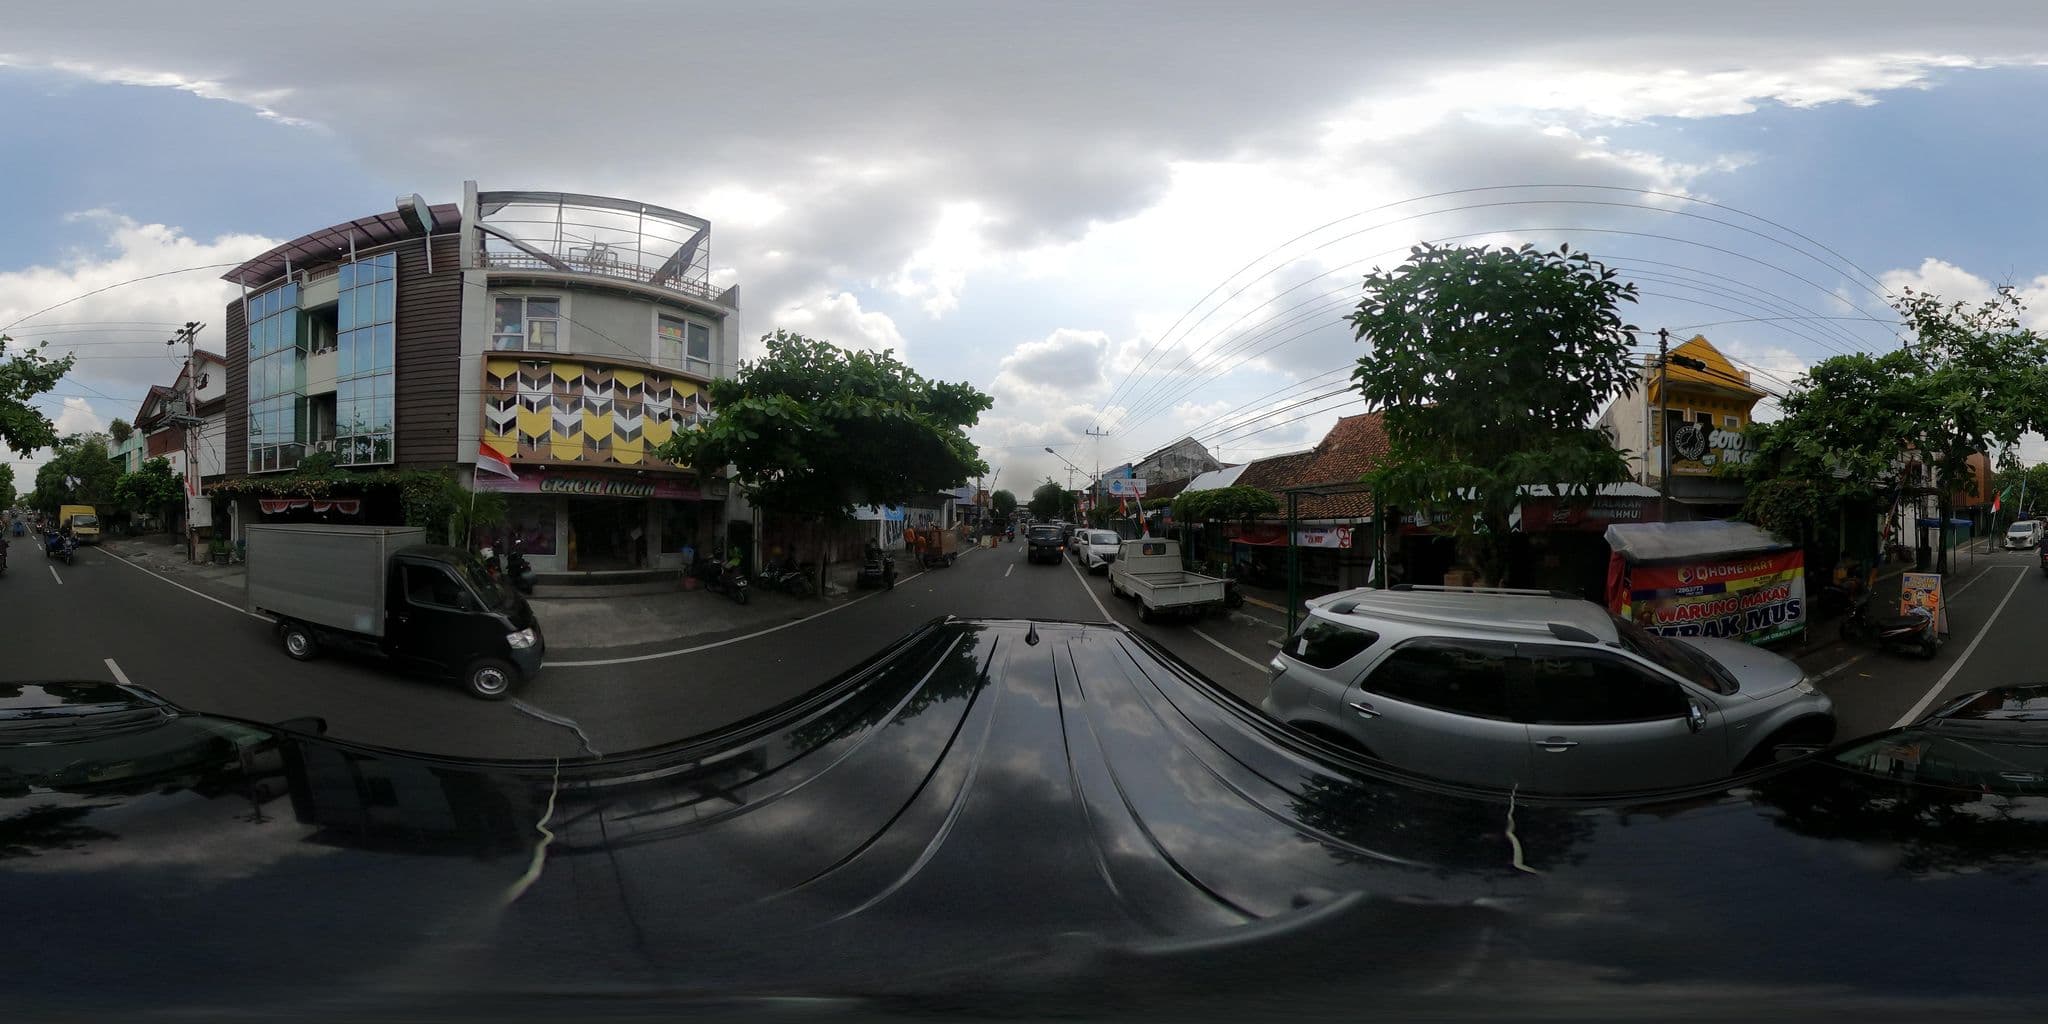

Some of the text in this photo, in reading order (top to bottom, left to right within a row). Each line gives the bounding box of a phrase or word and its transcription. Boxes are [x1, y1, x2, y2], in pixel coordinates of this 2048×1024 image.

[1708, 430, 1744, 450] SOTO
[1656, 586, 1792, 623] WARUNG MAKAN
[1744, 598, 1801, 633] MUS
